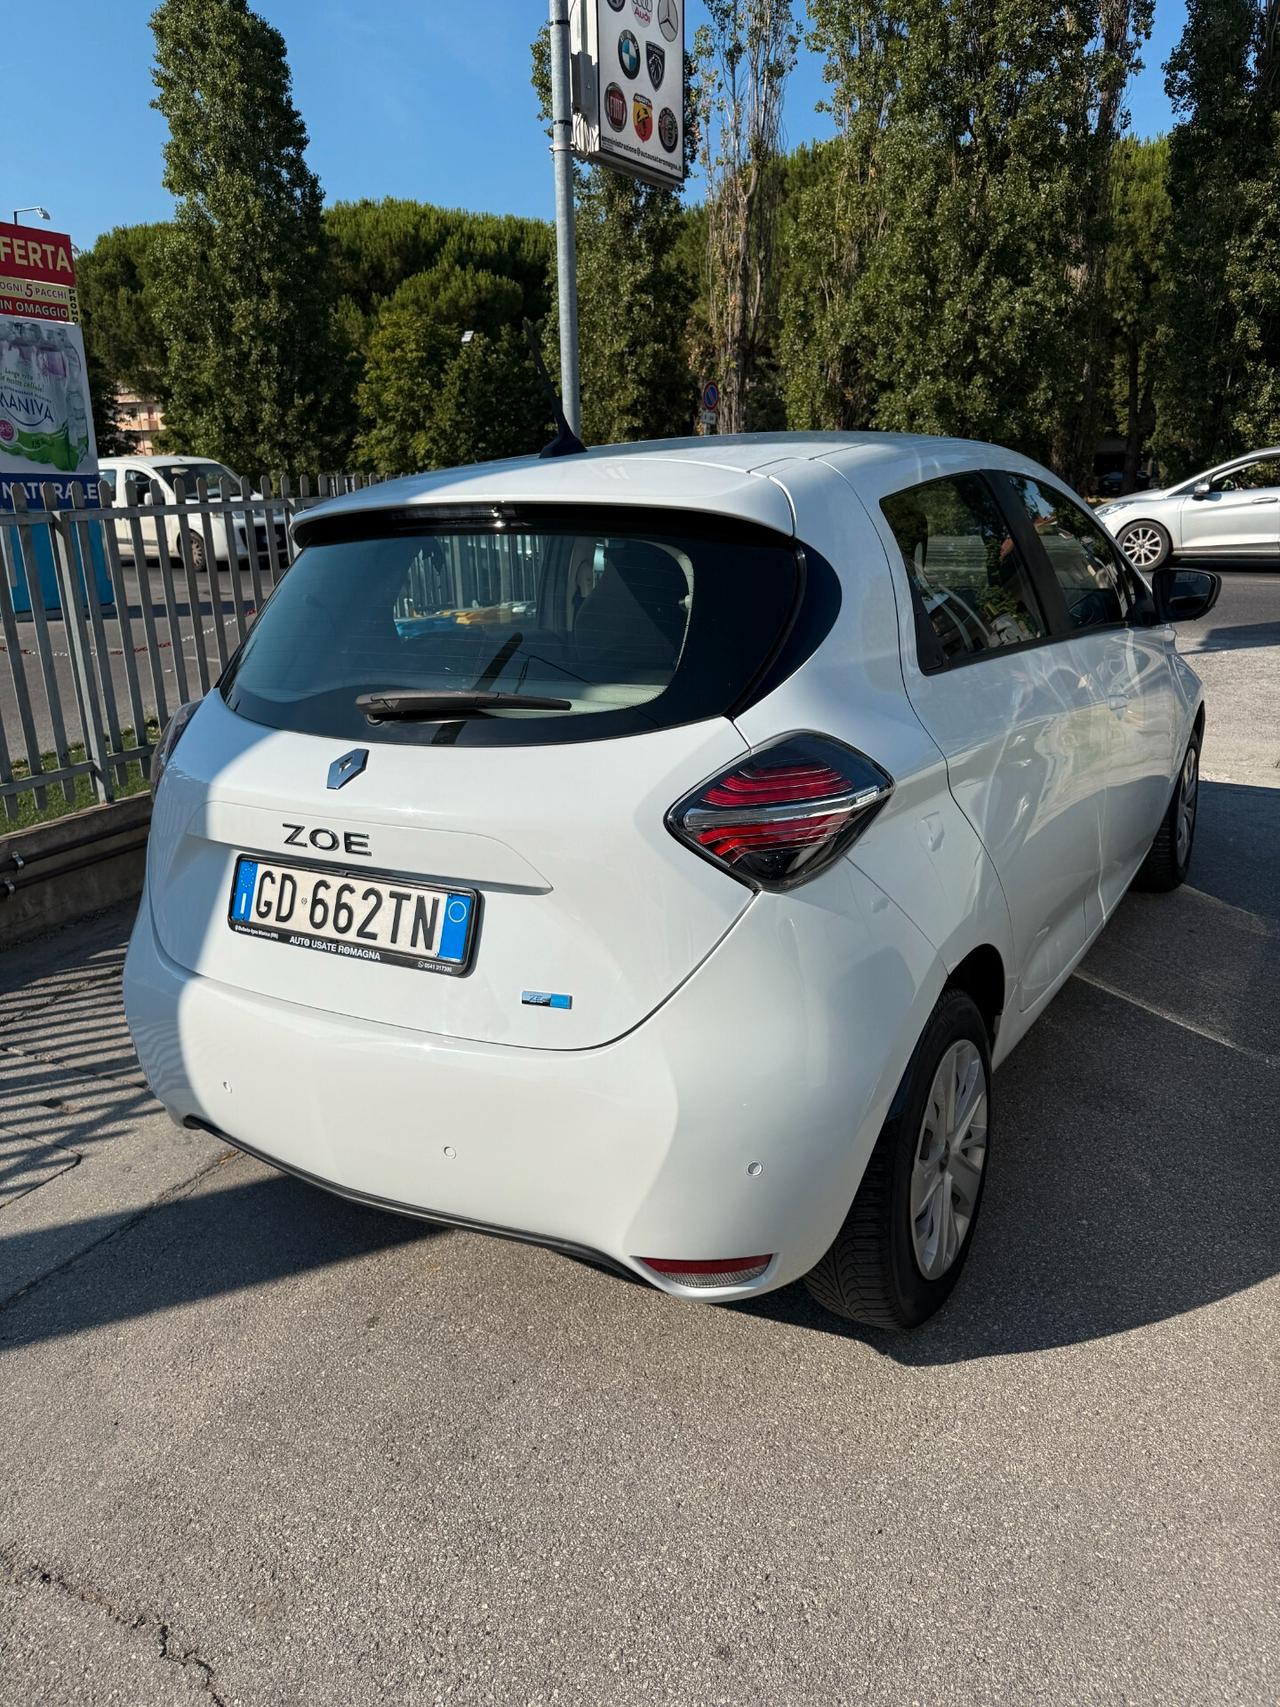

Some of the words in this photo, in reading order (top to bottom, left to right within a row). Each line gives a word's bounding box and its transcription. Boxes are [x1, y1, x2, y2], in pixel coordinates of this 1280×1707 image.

[633, 6, 652, 24] Audi
[0, 235, 72, 273] FERTA
[0, 282, 23, 293] OGNI
[25, 283, 33, 298] 5
[35, 287, 67, 299] PACCHI
[68, 288, 79, 323] PROMO
[0, 300, 12, 310] IN
[15, 301, 68, 318] OMAGGIO
[282, 822, 373, 857] ZOE
[255, 870, 298, 923] GD
[308, 879, 440, 951] 662TN
[289, 935, 310, 947] AUTO
[311, 939, 337, 953] USATE
[338, 945, 381, 961] ROMAGNA
